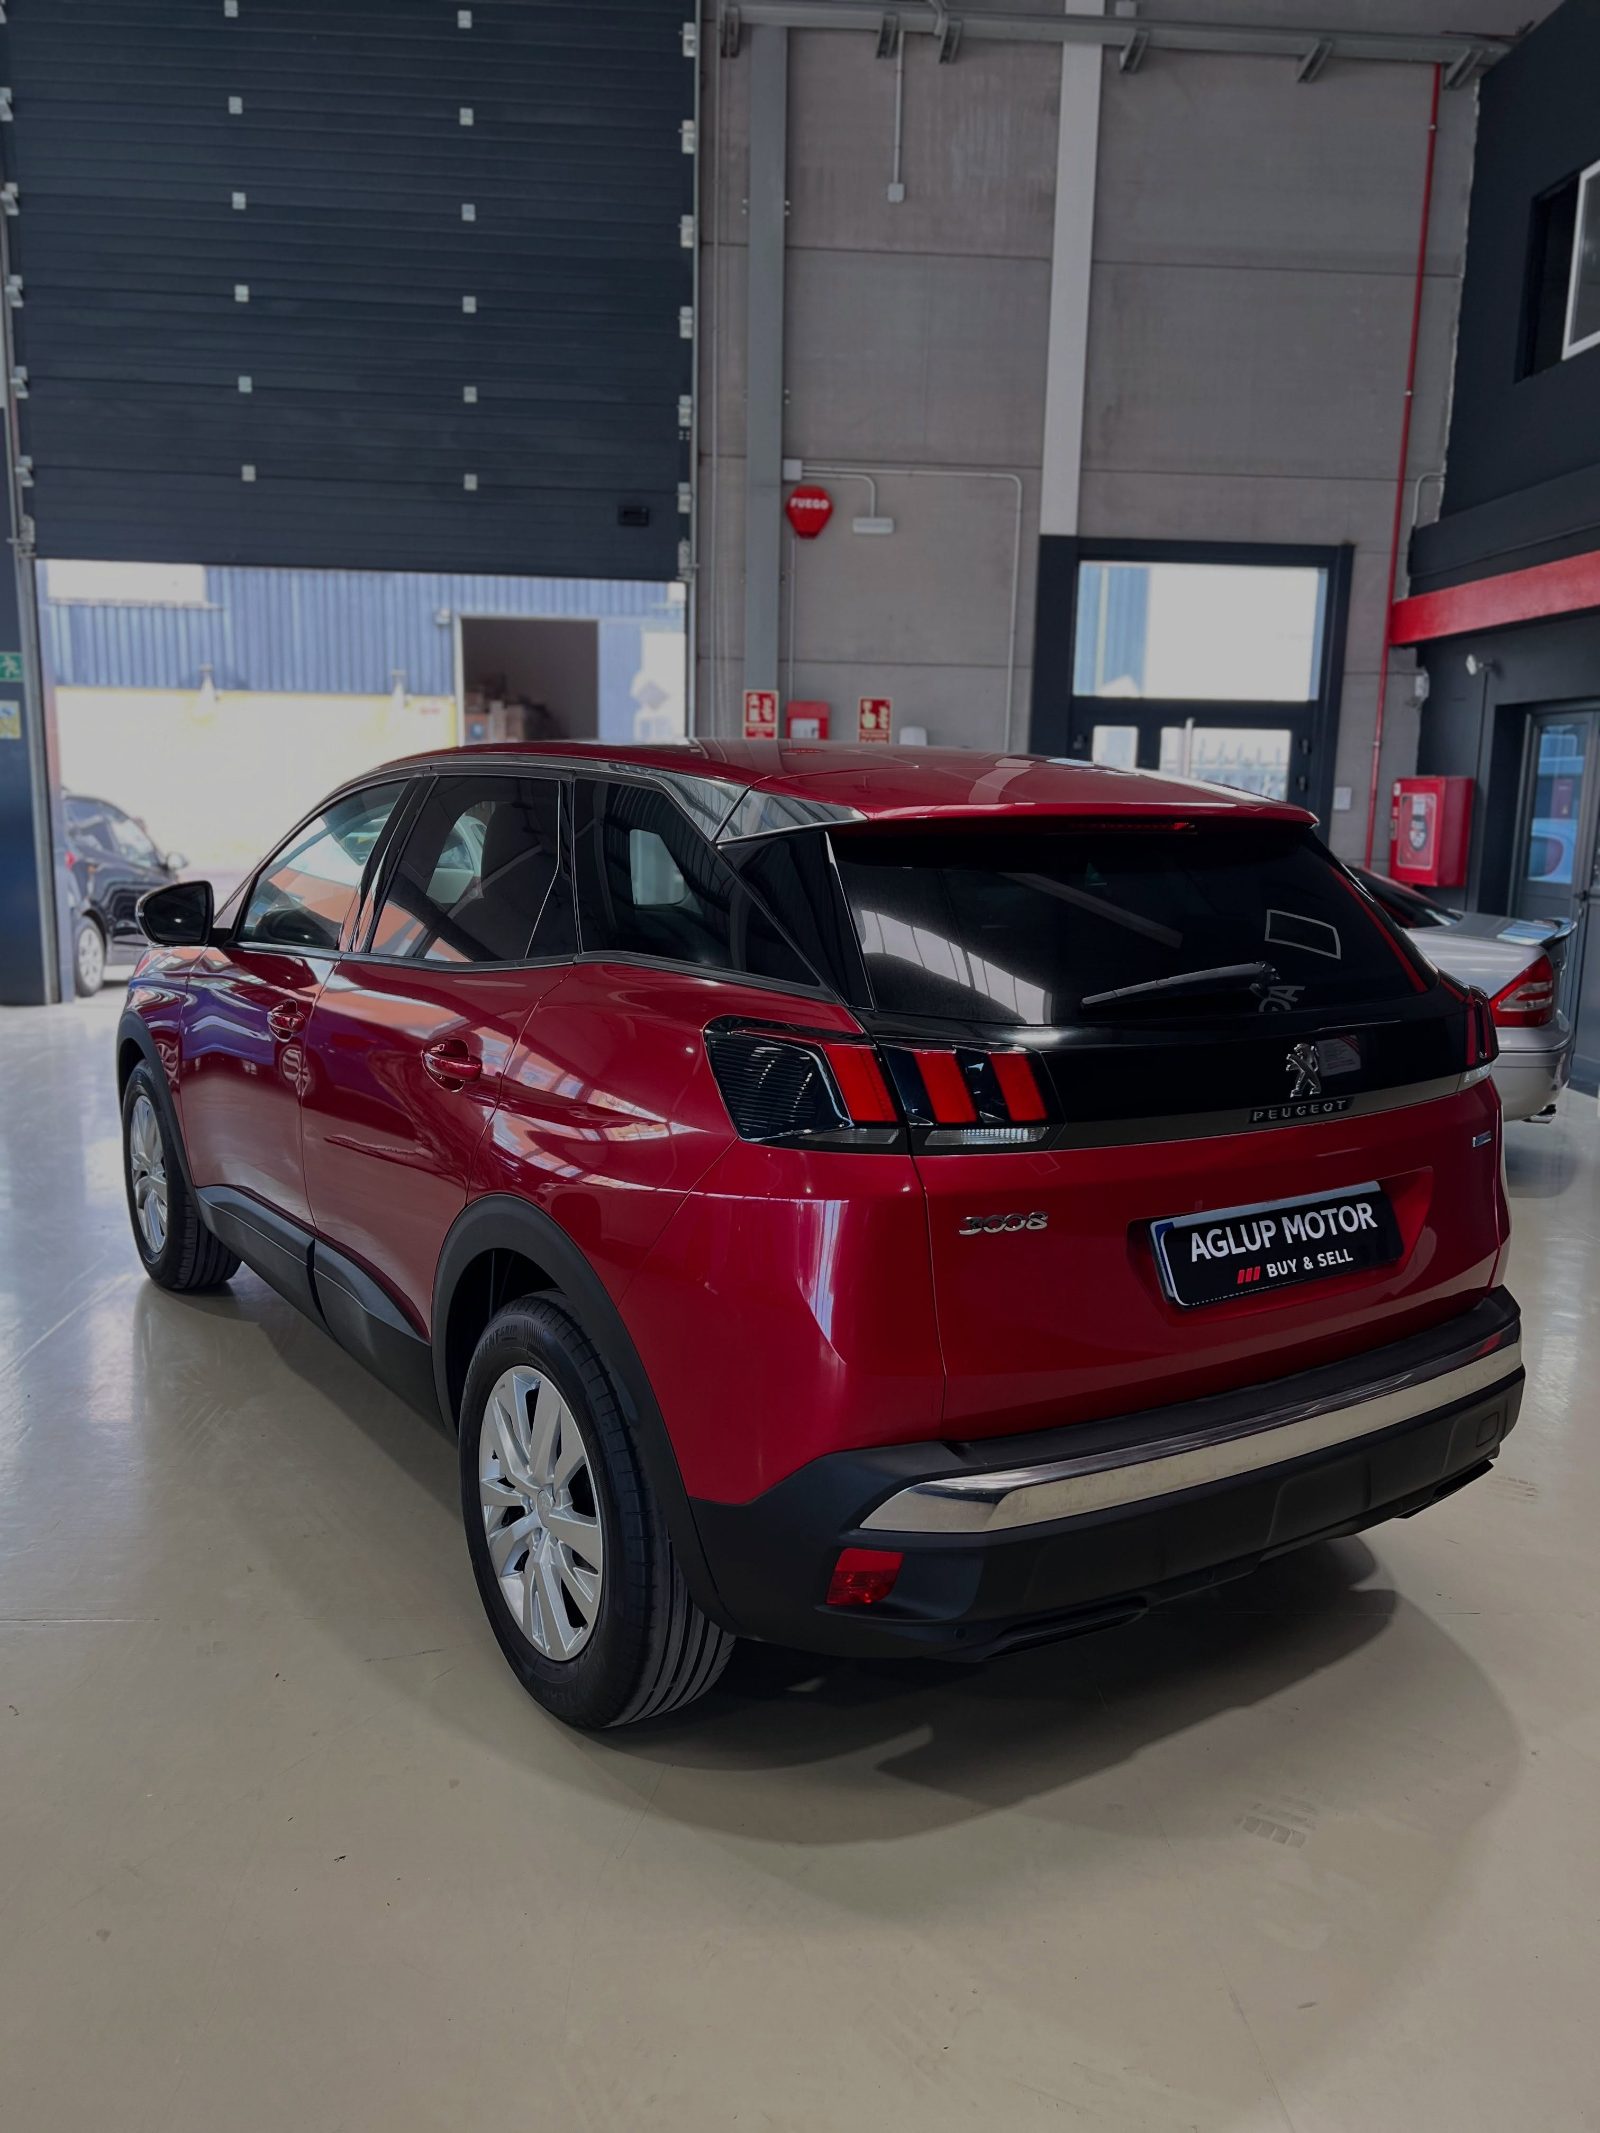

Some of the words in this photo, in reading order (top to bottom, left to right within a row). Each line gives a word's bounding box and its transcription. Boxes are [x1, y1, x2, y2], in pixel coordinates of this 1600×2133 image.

[790, 497, 830, 510] FUEGO
[1252, 1099, 1346, 1122] PEUGEOT
[958, 1211, 1049, 1235] 3008
[1190, 1219, 1277, 1263] AGLUP
[1281, 1201, 1378, 1244] MOTOR
[1266, 1258, 1297, 1278] BUY
[1303, 1256, 1314, 1270] &
[1317, 1248, 1354, 1267] SELL
